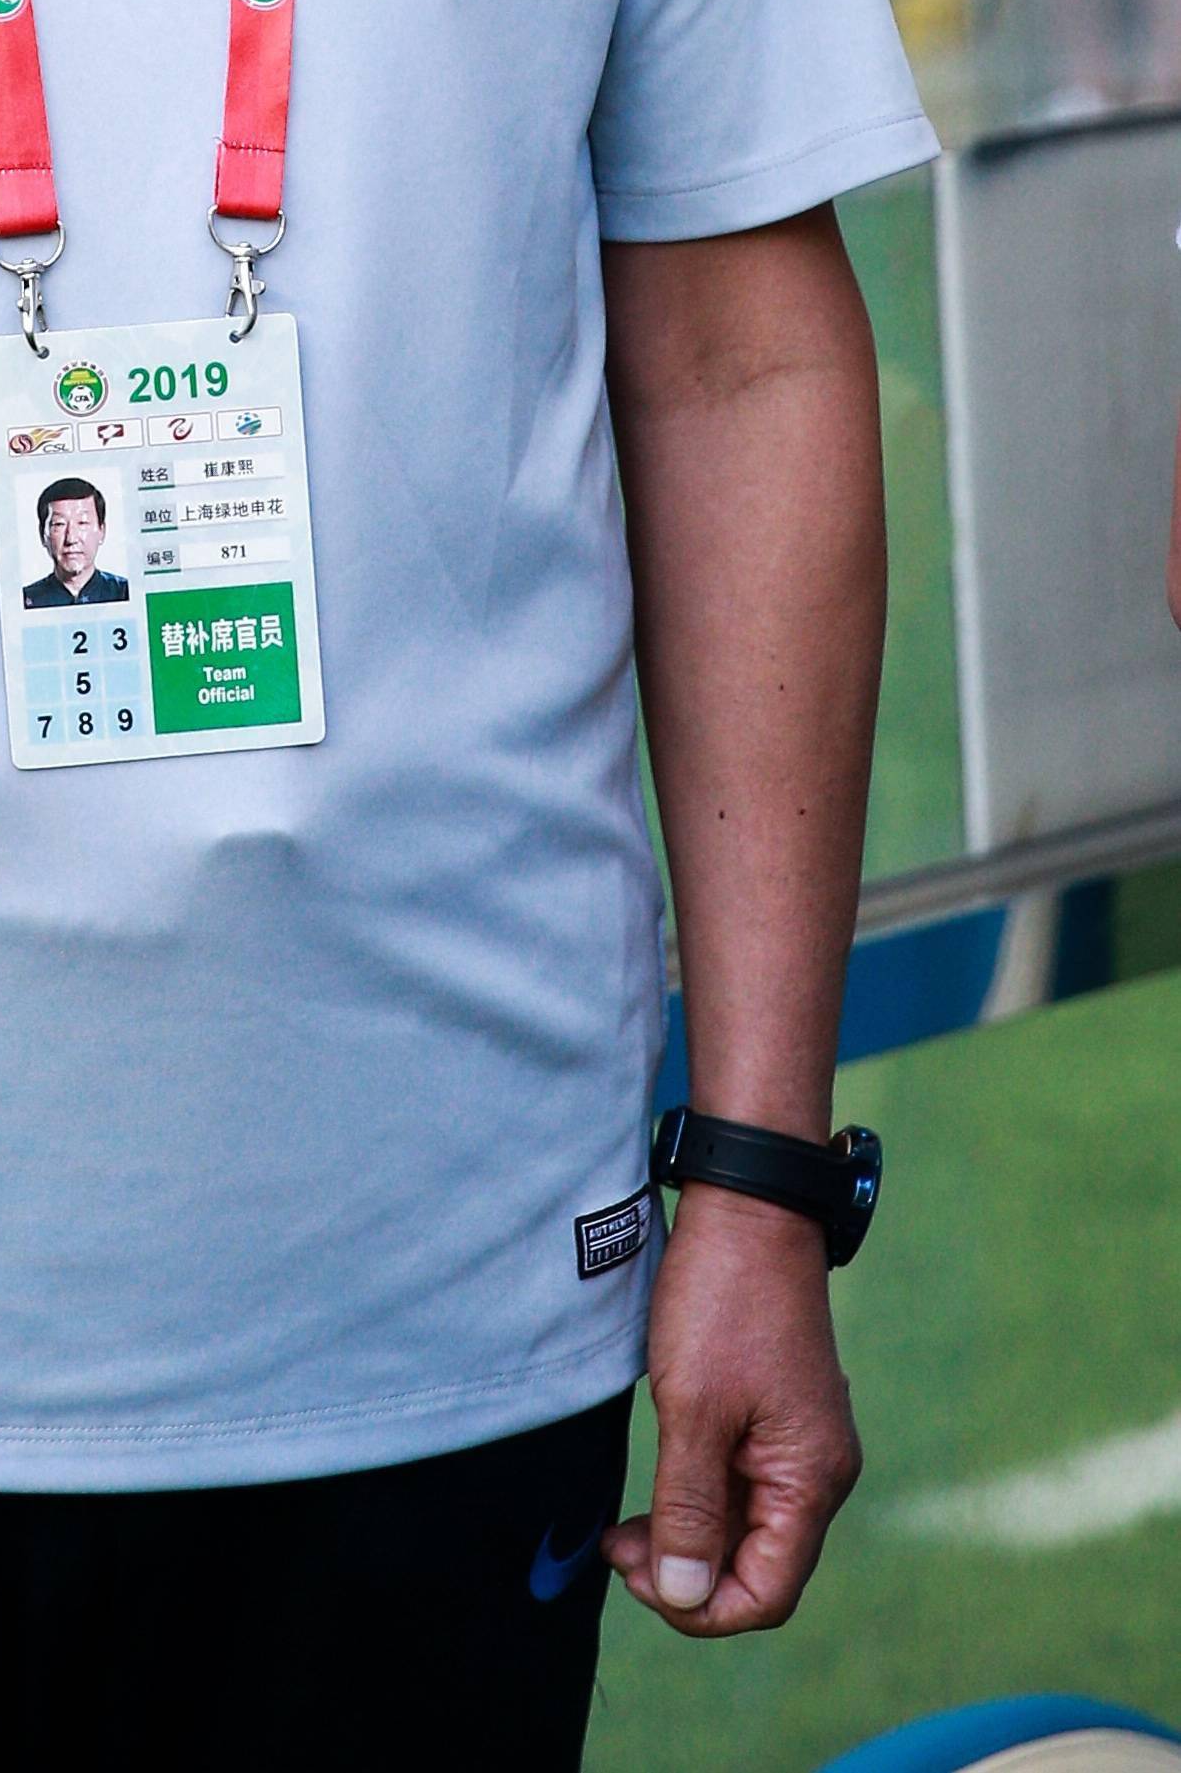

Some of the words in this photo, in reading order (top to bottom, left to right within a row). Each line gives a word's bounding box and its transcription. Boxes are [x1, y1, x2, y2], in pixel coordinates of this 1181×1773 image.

[128, 362, 229, 403] 2019
[74, 395, 90, 403] CFA
[141, 467, 169, 483] 姓名
[204, 459, 255, 478] 崔康熙
[144, 509, 172, 524] 单位
[180, 498, 284, 522] 上海绿地申花
[146, 550, 175, 566] 编号
[221, 545, 246, 559] 871
[73, 630, 89, 654] 2
[112, 628, 128, 651] 3
[161, 614, 284, 658] 替补席官员
[76, 671, 92, 695] 5
[203, 664, 247, 684] Team
[198, 685, 255, 705] Official
[37, 715, 53, 739] 7
[78, 712, 94, 736] 8
[117, 708, 134, 732] 9
